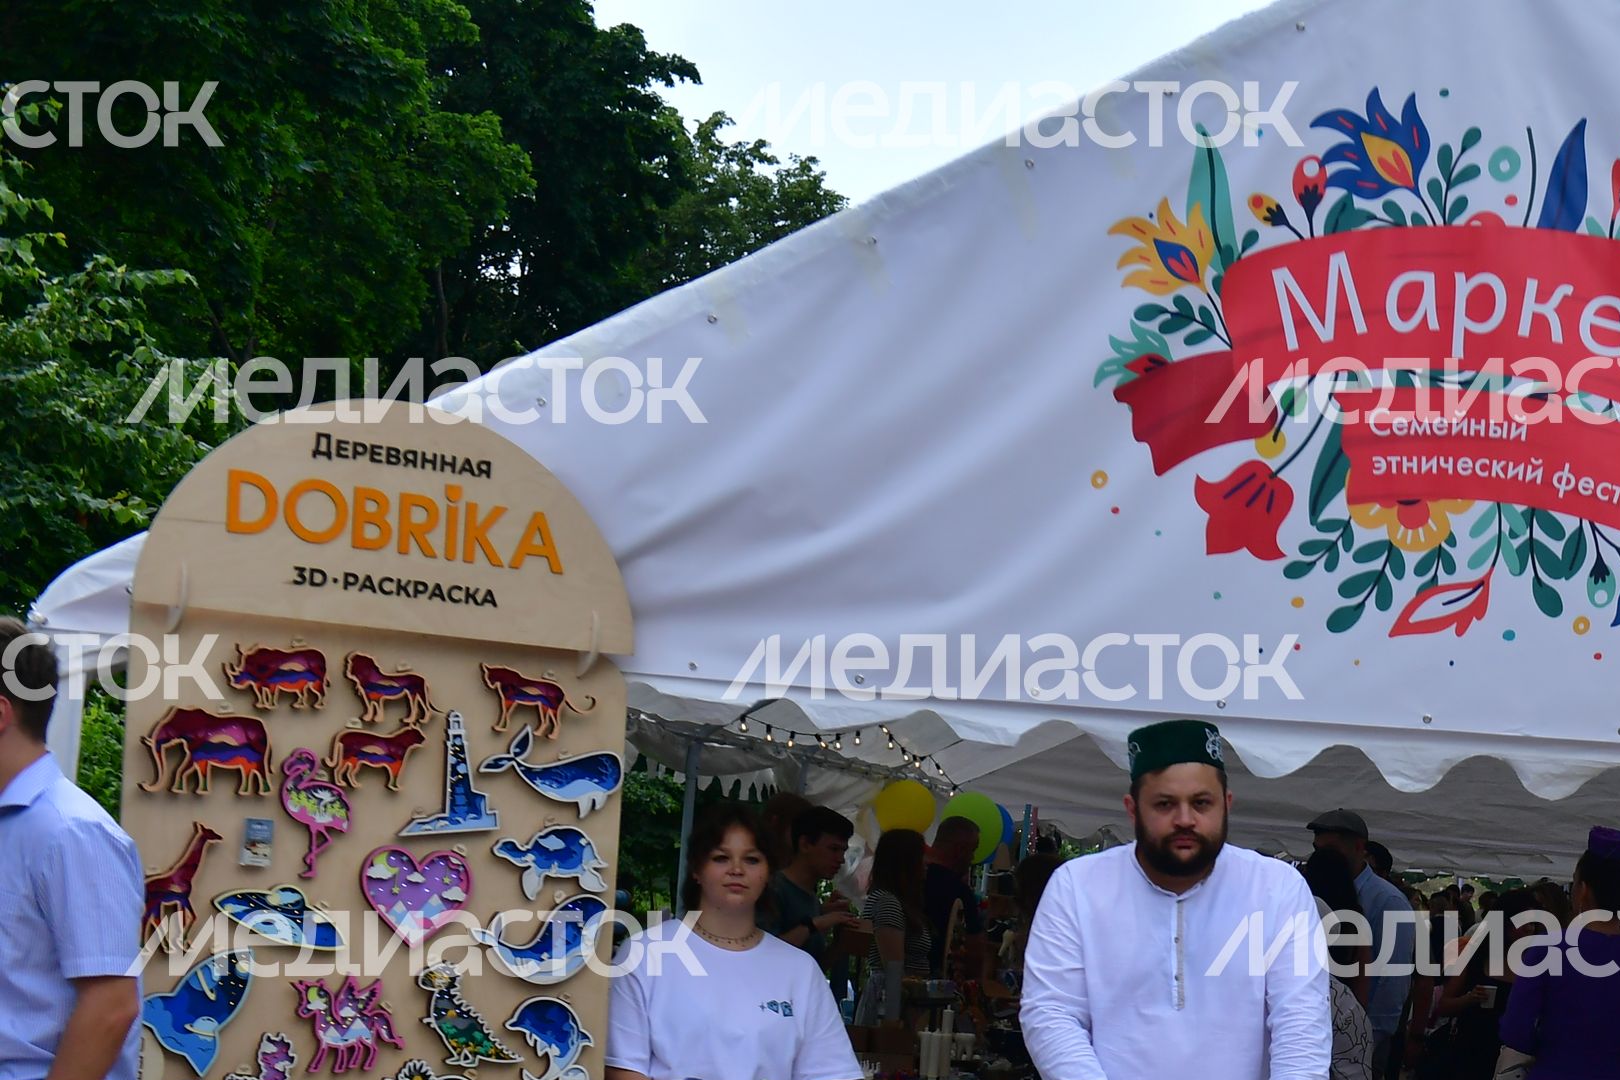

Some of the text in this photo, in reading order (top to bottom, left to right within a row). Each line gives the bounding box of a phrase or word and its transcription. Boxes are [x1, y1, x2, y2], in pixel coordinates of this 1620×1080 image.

[1369, 407, 1528, 442] Семейный
[312, 431, 492, 479] ДЕРЕВЯННАЯ
[1372, 454, 1544, 485] этнический
